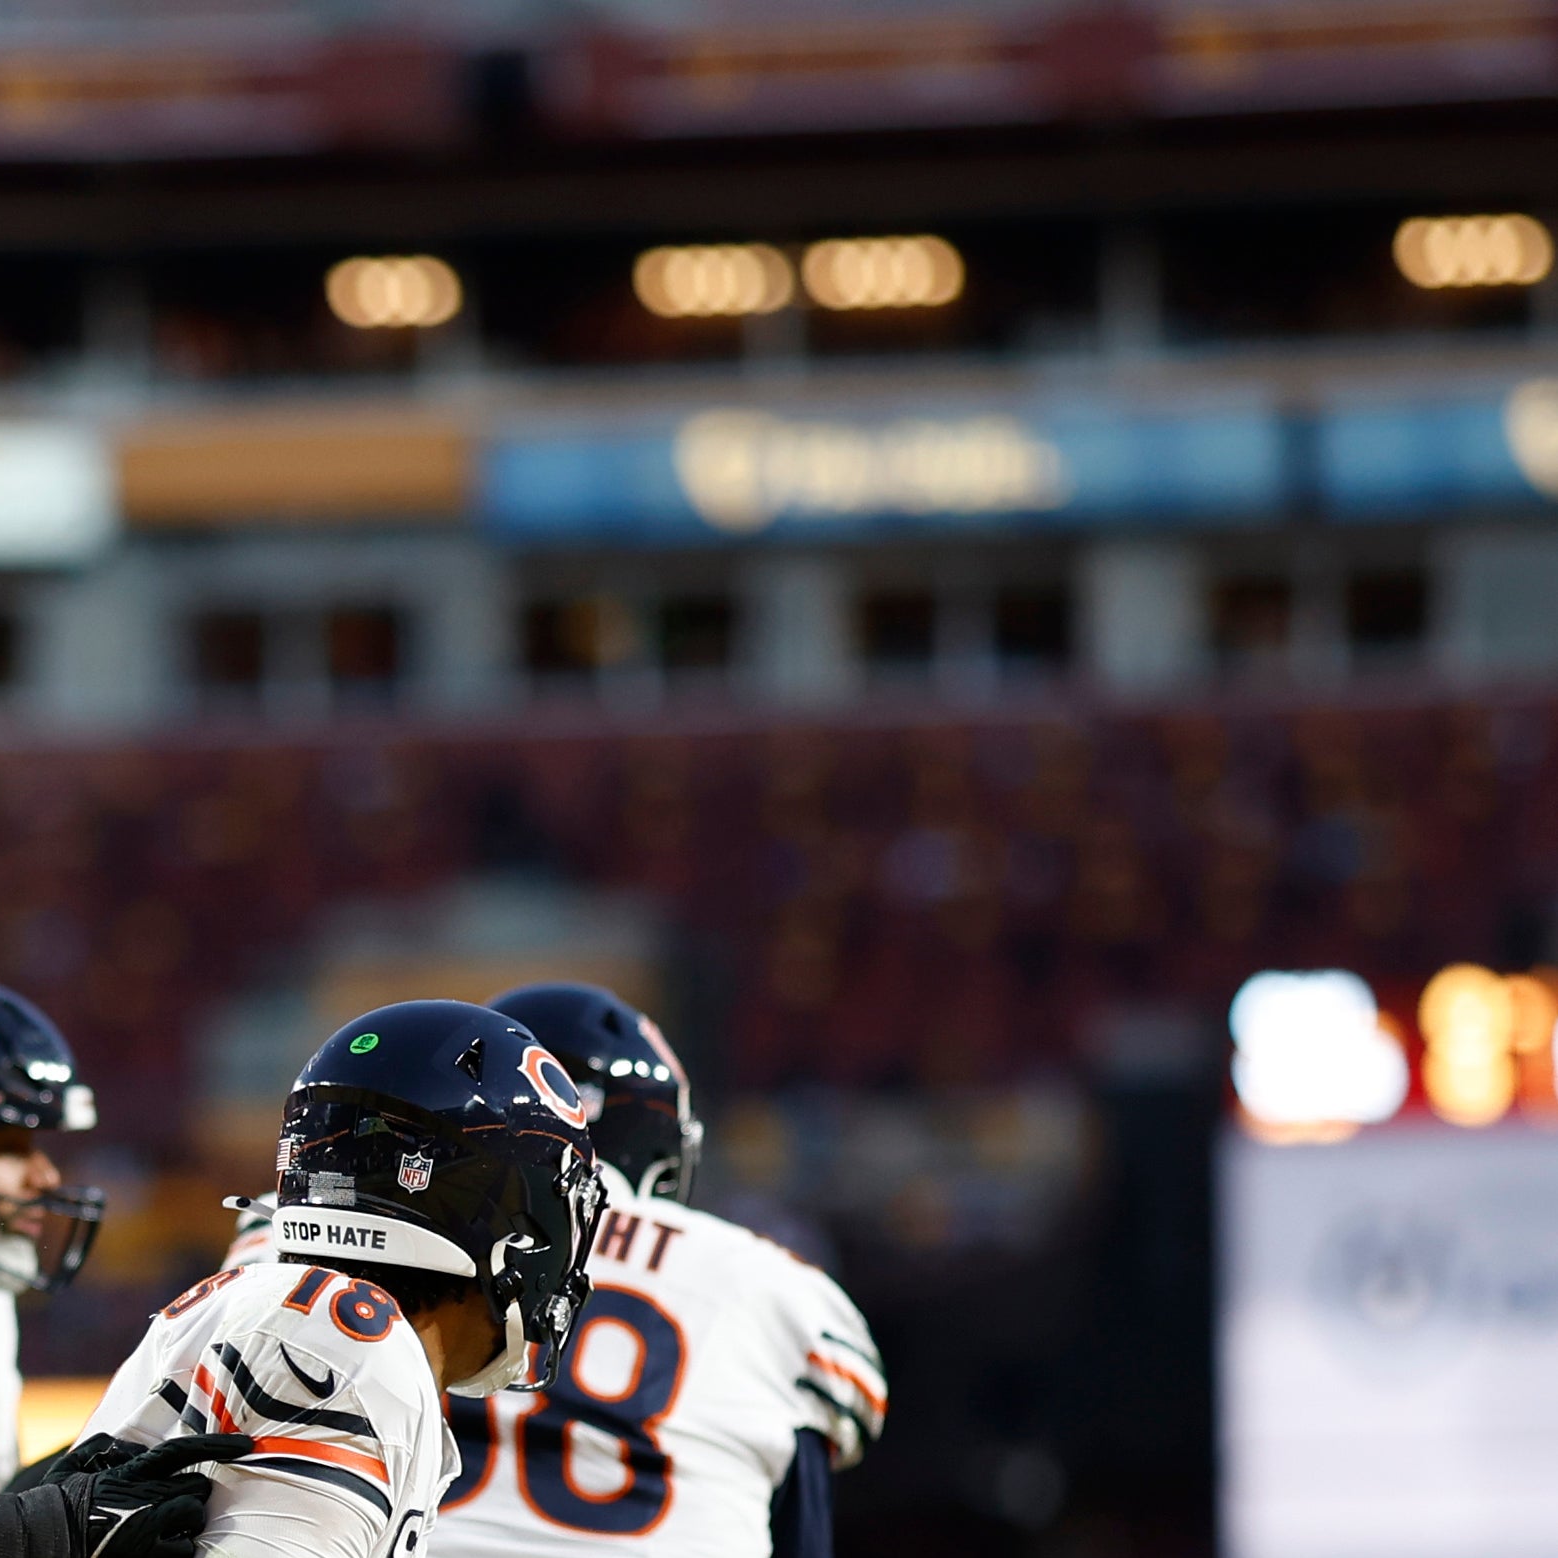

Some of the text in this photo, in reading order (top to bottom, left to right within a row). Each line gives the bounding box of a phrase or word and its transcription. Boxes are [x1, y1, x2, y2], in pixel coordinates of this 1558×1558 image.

[402, 1168, 427, 1187] NFL
[283, 1220, 387, 1250] STOP HATE
[281, 1265, 402, 1342] 18
